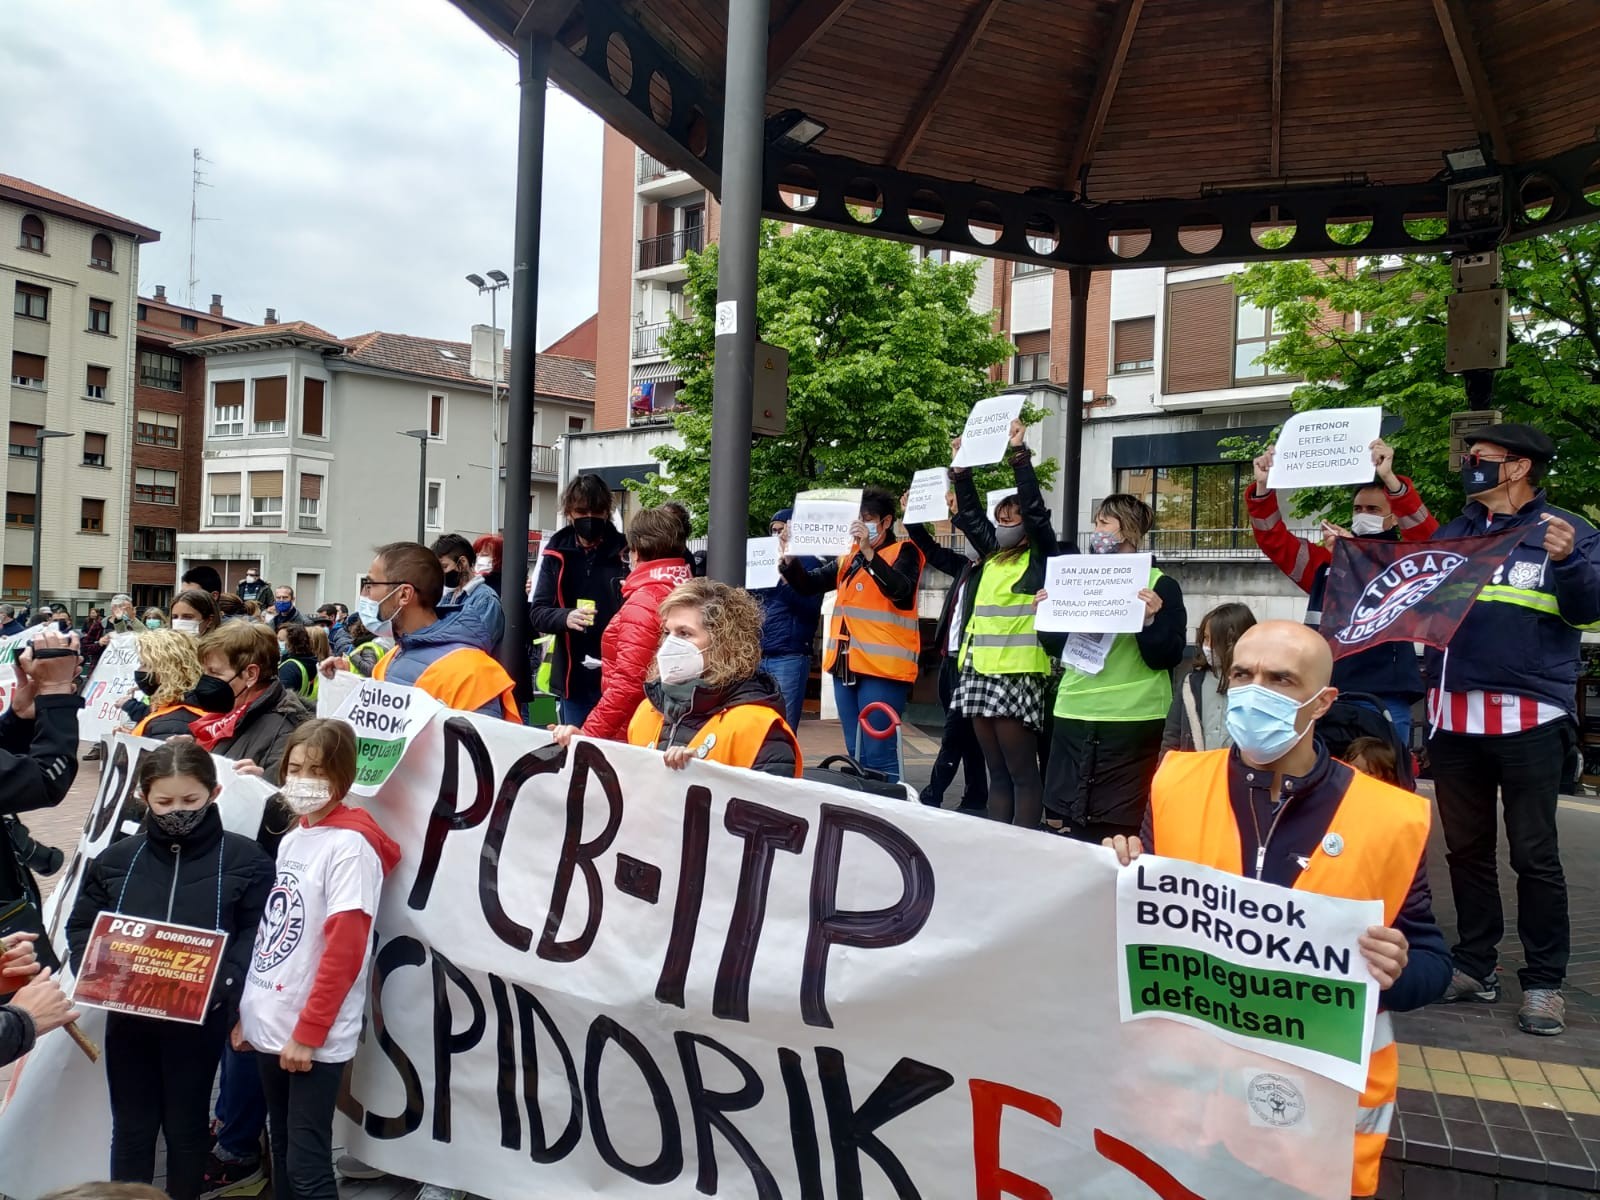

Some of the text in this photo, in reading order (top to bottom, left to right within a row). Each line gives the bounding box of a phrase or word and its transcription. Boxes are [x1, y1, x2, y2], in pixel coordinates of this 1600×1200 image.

[1298, 421, 1350, 432] PETRONOR
[1298, 435, 1331, 446] ERTErik
[1283, 445, 1364, 460] SIN PERSONAL NO
[1286, 458, 1360, 471] HAY SEGURIDAD
[793, 523, 848, 533] EN PCB-ITP NO
[794, 535, 845, 545] SOBRA NADIE
[1061, 567, 1077, 575] SAN
[1078, 567, 1099, 575] JUAN
[1101, 567, 1112, 575] DE
[1083, 578, 1134, 586] HITZARMENIK
[1087, 599, 1125, 607] PRECARIO
[1089, 609, 1128, 617] PRECARIO
[407, 716, 936, 1028] PCB-ITP
[1137, 865, 1306, 929] Langileok
[108, 919, 215, 948] PCB BORROKAN
[1137, 901, 1350, 975] BORROKAN
[109, 941, 211, 974] DESPIDOrik EZ!
[134, 955, 170, 968] ITP Aero
[131, 963, 206, 984] RESPONSABLE
[1137, 946, 1355, 1010] Enpleguaren
[137, 1005, 167, 1016] EMPRESA
[1141, 981, 1305, 1040] defentsan
